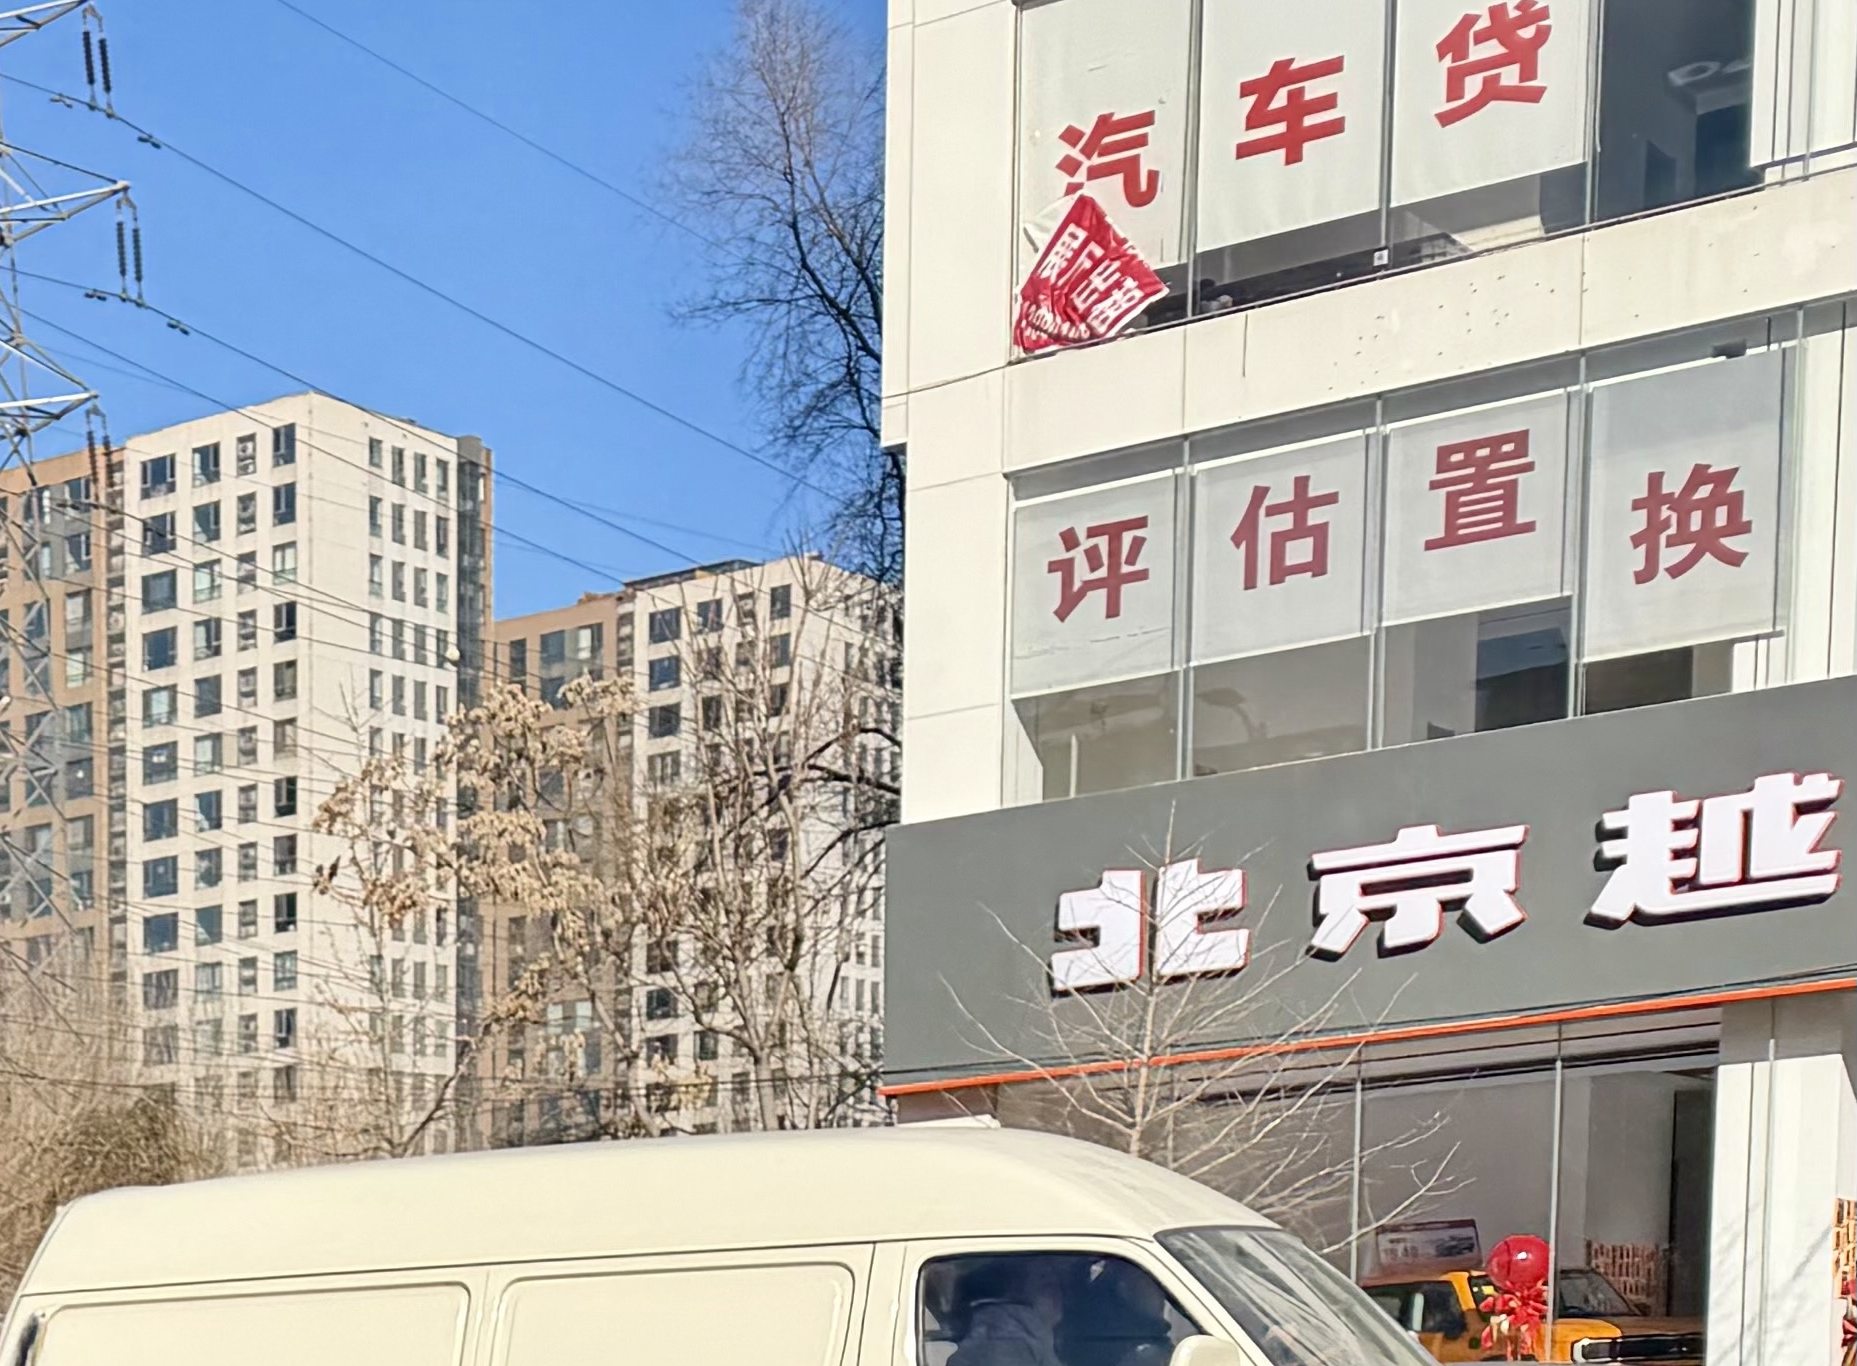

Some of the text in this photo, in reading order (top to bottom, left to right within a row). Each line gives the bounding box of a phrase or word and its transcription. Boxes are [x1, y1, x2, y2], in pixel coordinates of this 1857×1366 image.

[1055, 0, 1552, 208] 汽车贷
[1047, 429, 1753, 624] 评估置换
[1050, 771, 1844, 992] 北京越
